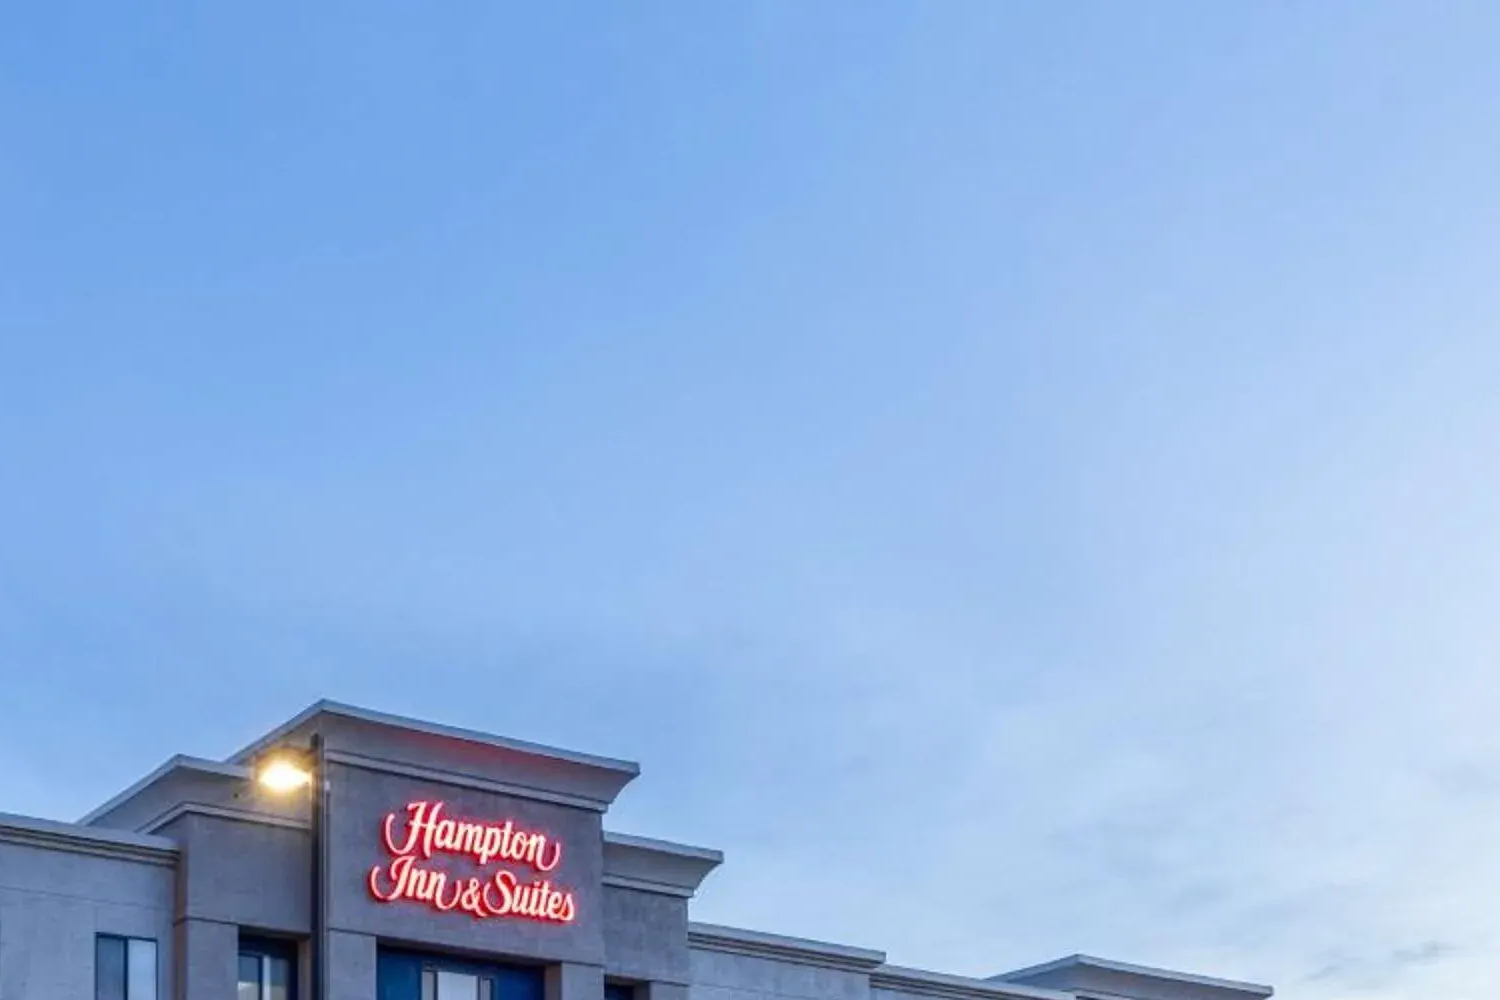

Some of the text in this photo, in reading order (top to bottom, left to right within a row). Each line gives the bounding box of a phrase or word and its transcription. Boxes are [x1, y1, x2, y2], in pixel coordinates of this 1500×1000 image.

[384, 801, 561, 871] Hampton
[370, 855, 575, 921] Inn & Suites
